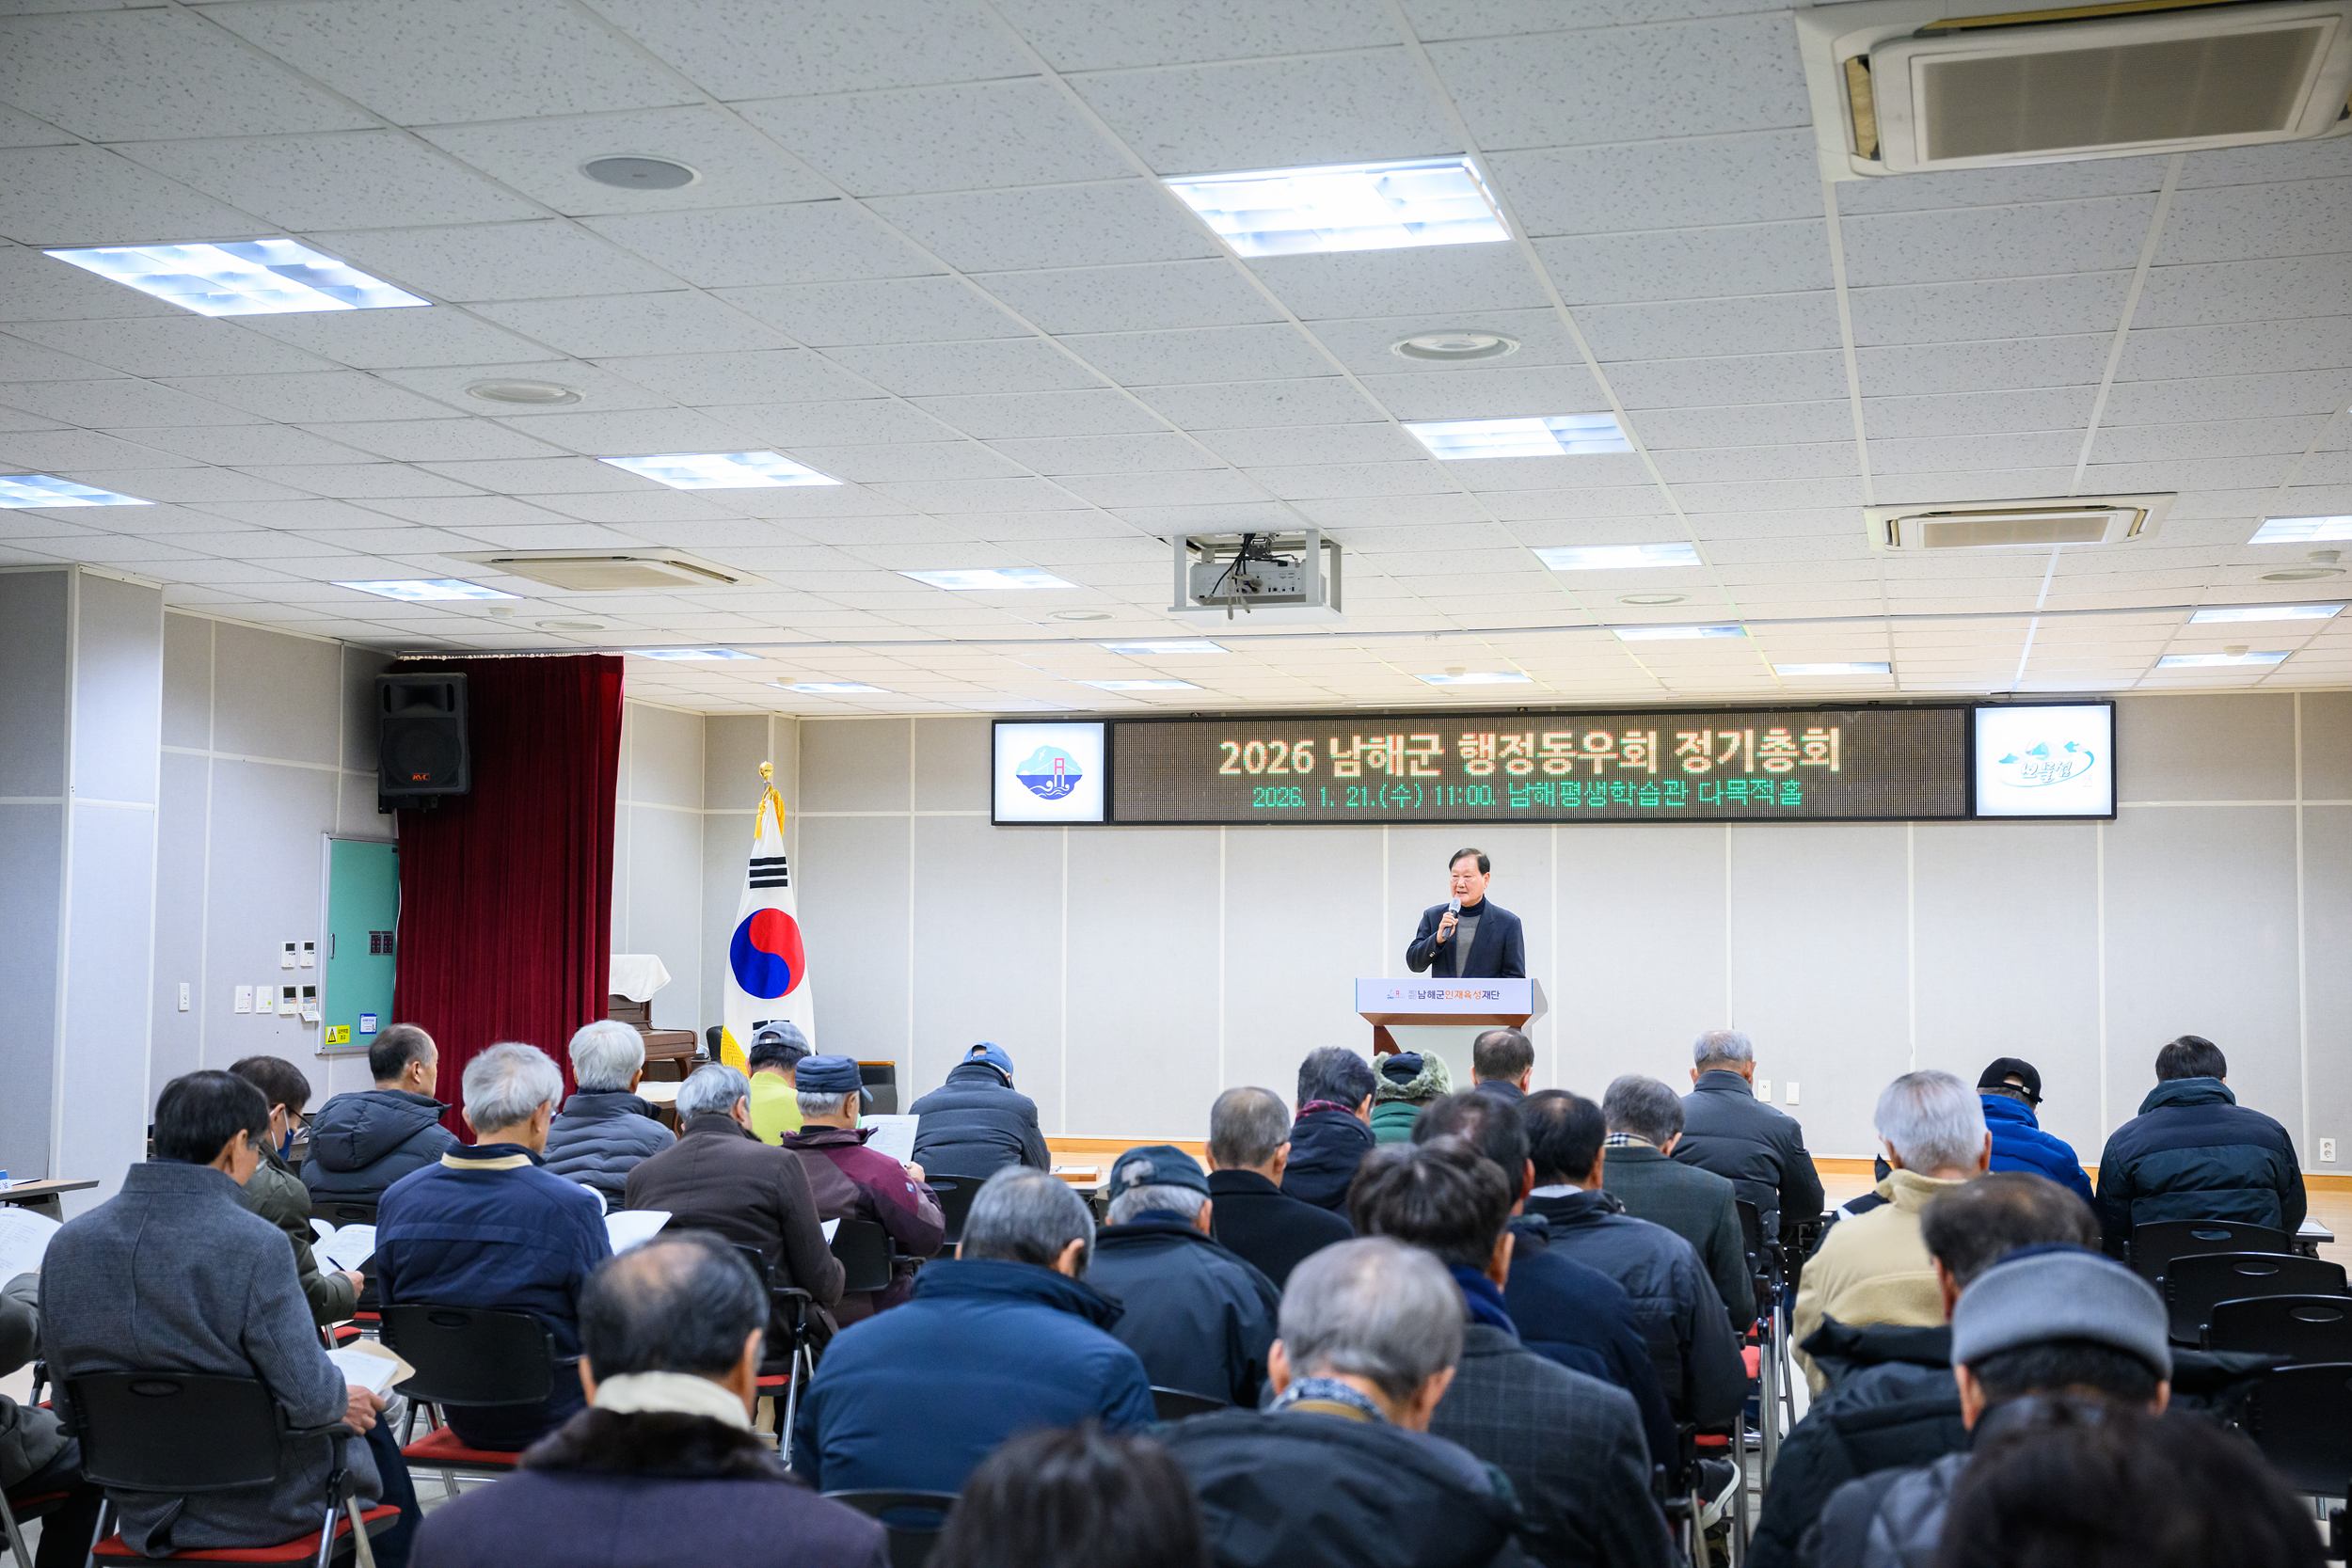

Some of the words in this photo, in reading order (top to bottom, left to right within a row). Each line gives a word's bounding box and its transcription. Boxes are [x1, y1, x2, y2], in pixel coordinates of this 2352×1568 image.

[1219, 739, 1314, 774] 2026
[1328, 734, 1445, 777] 남해군
[1458, 731, 1657, 776] 행정동우회
[1675, 727, 1839, 774] 정기총회
[1253, 786, 1306, 808] 2026.
[1320, 785, 1335, 807] 1.
[1346, 782, 1423, 809] 21.(수)
[1436, 784, 1497, 806] 11:00.
[1508, 780, 1689, 808] 남해평생학습관
[1699, 778, 1804, 806] 다목적홀
